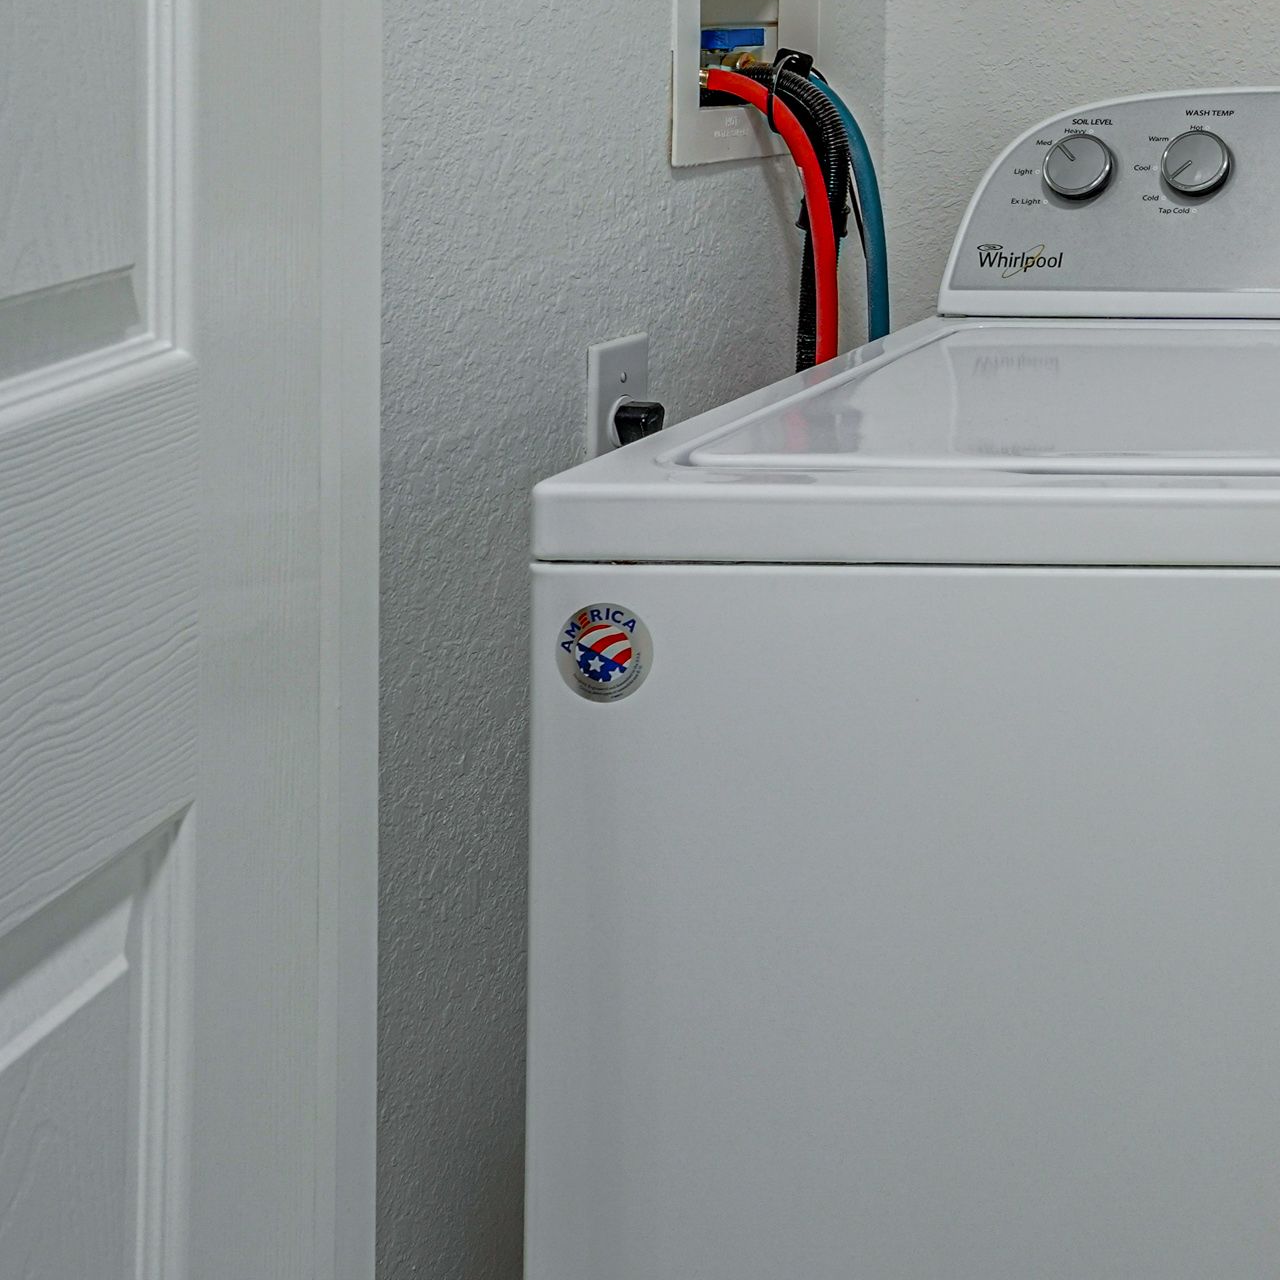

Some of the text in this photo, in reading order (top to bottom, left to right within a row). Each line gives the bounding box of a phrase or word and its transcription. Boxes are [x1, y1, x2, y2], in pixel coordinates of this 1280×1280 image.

[1014, 168, 1033, 176] Light
[1021, 198, 1041, 206] Light
[1158, 207, 1172, 215] Tap
[979, 252, 1063, 272] Whirlpool
[560, 608, 637, 654] AMERICA
